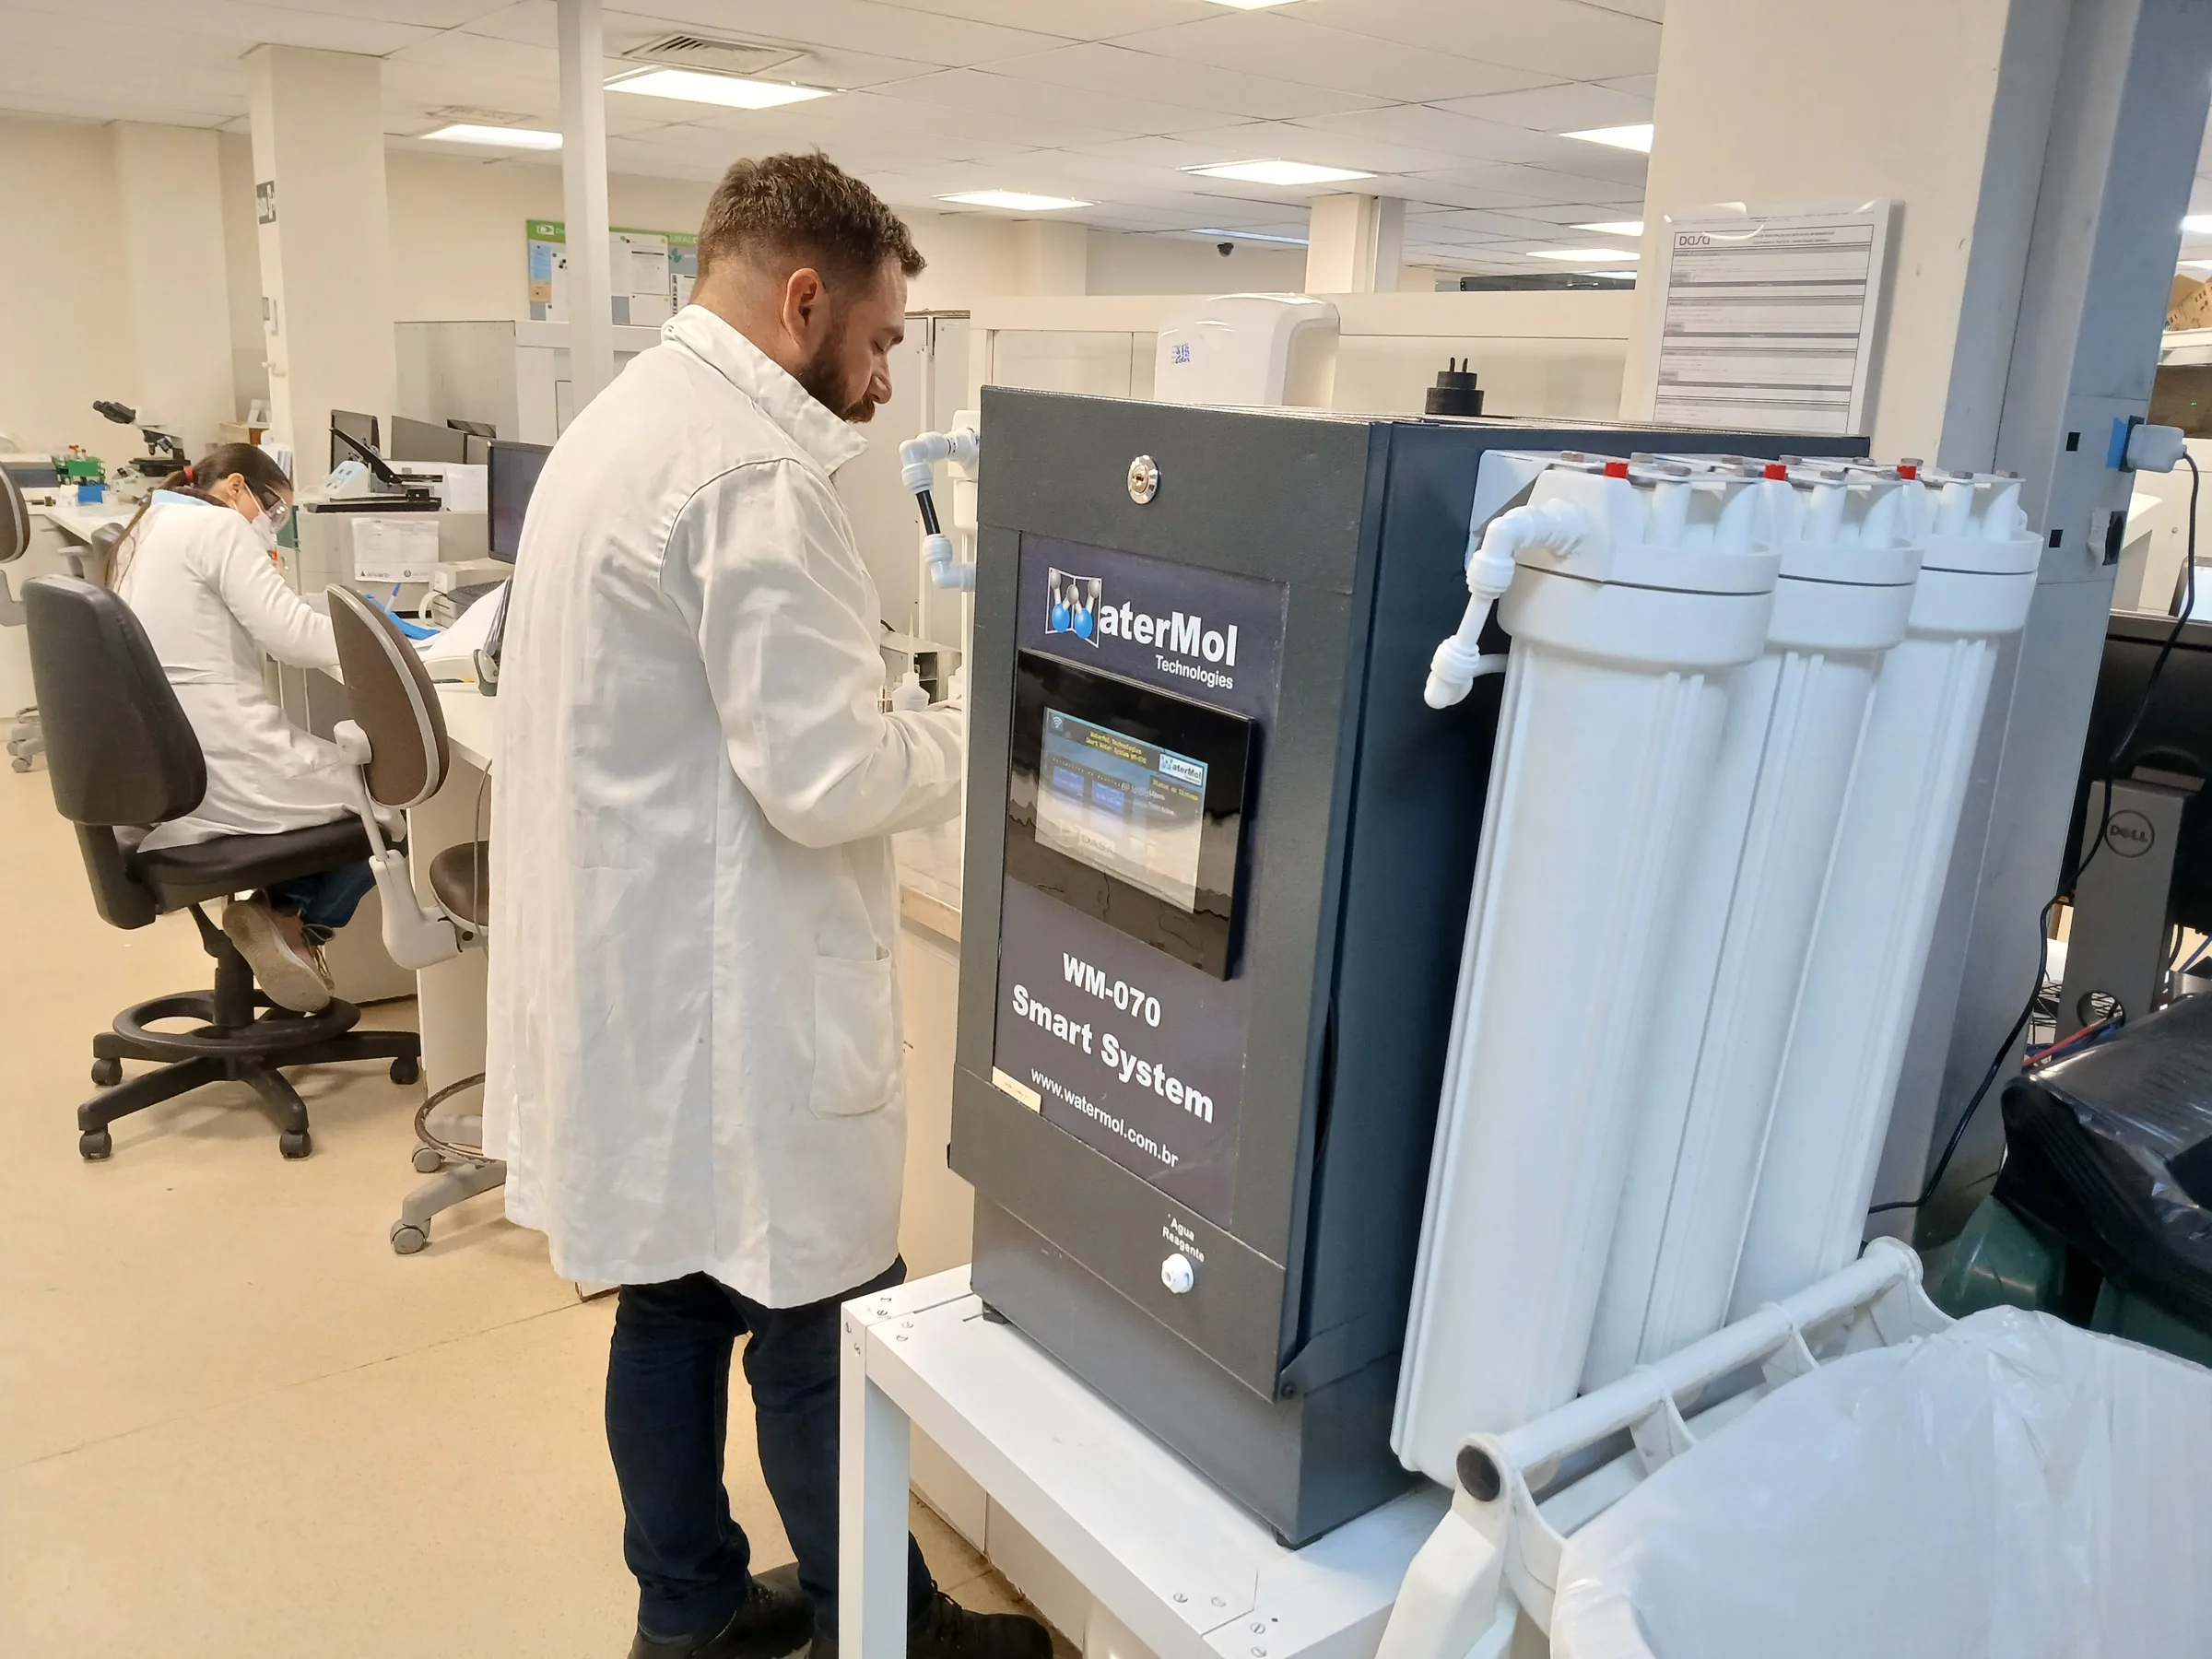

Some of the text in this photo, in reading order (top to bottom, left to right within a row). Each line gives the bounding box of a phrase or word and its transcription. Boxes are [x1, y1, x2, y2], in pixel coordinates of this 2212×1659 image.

[1155, 654, 1233, 689] Technologies
[2111, 825, 2148, 843] DELL
[1063, 952, 1161, 1028] WM-070
[1012, 984, 1215, 1124] Smart System
[1030, 1067, 1180, 1169] www.watermol.com.br
[1162, 1226, 1206, 1263] Reagente
